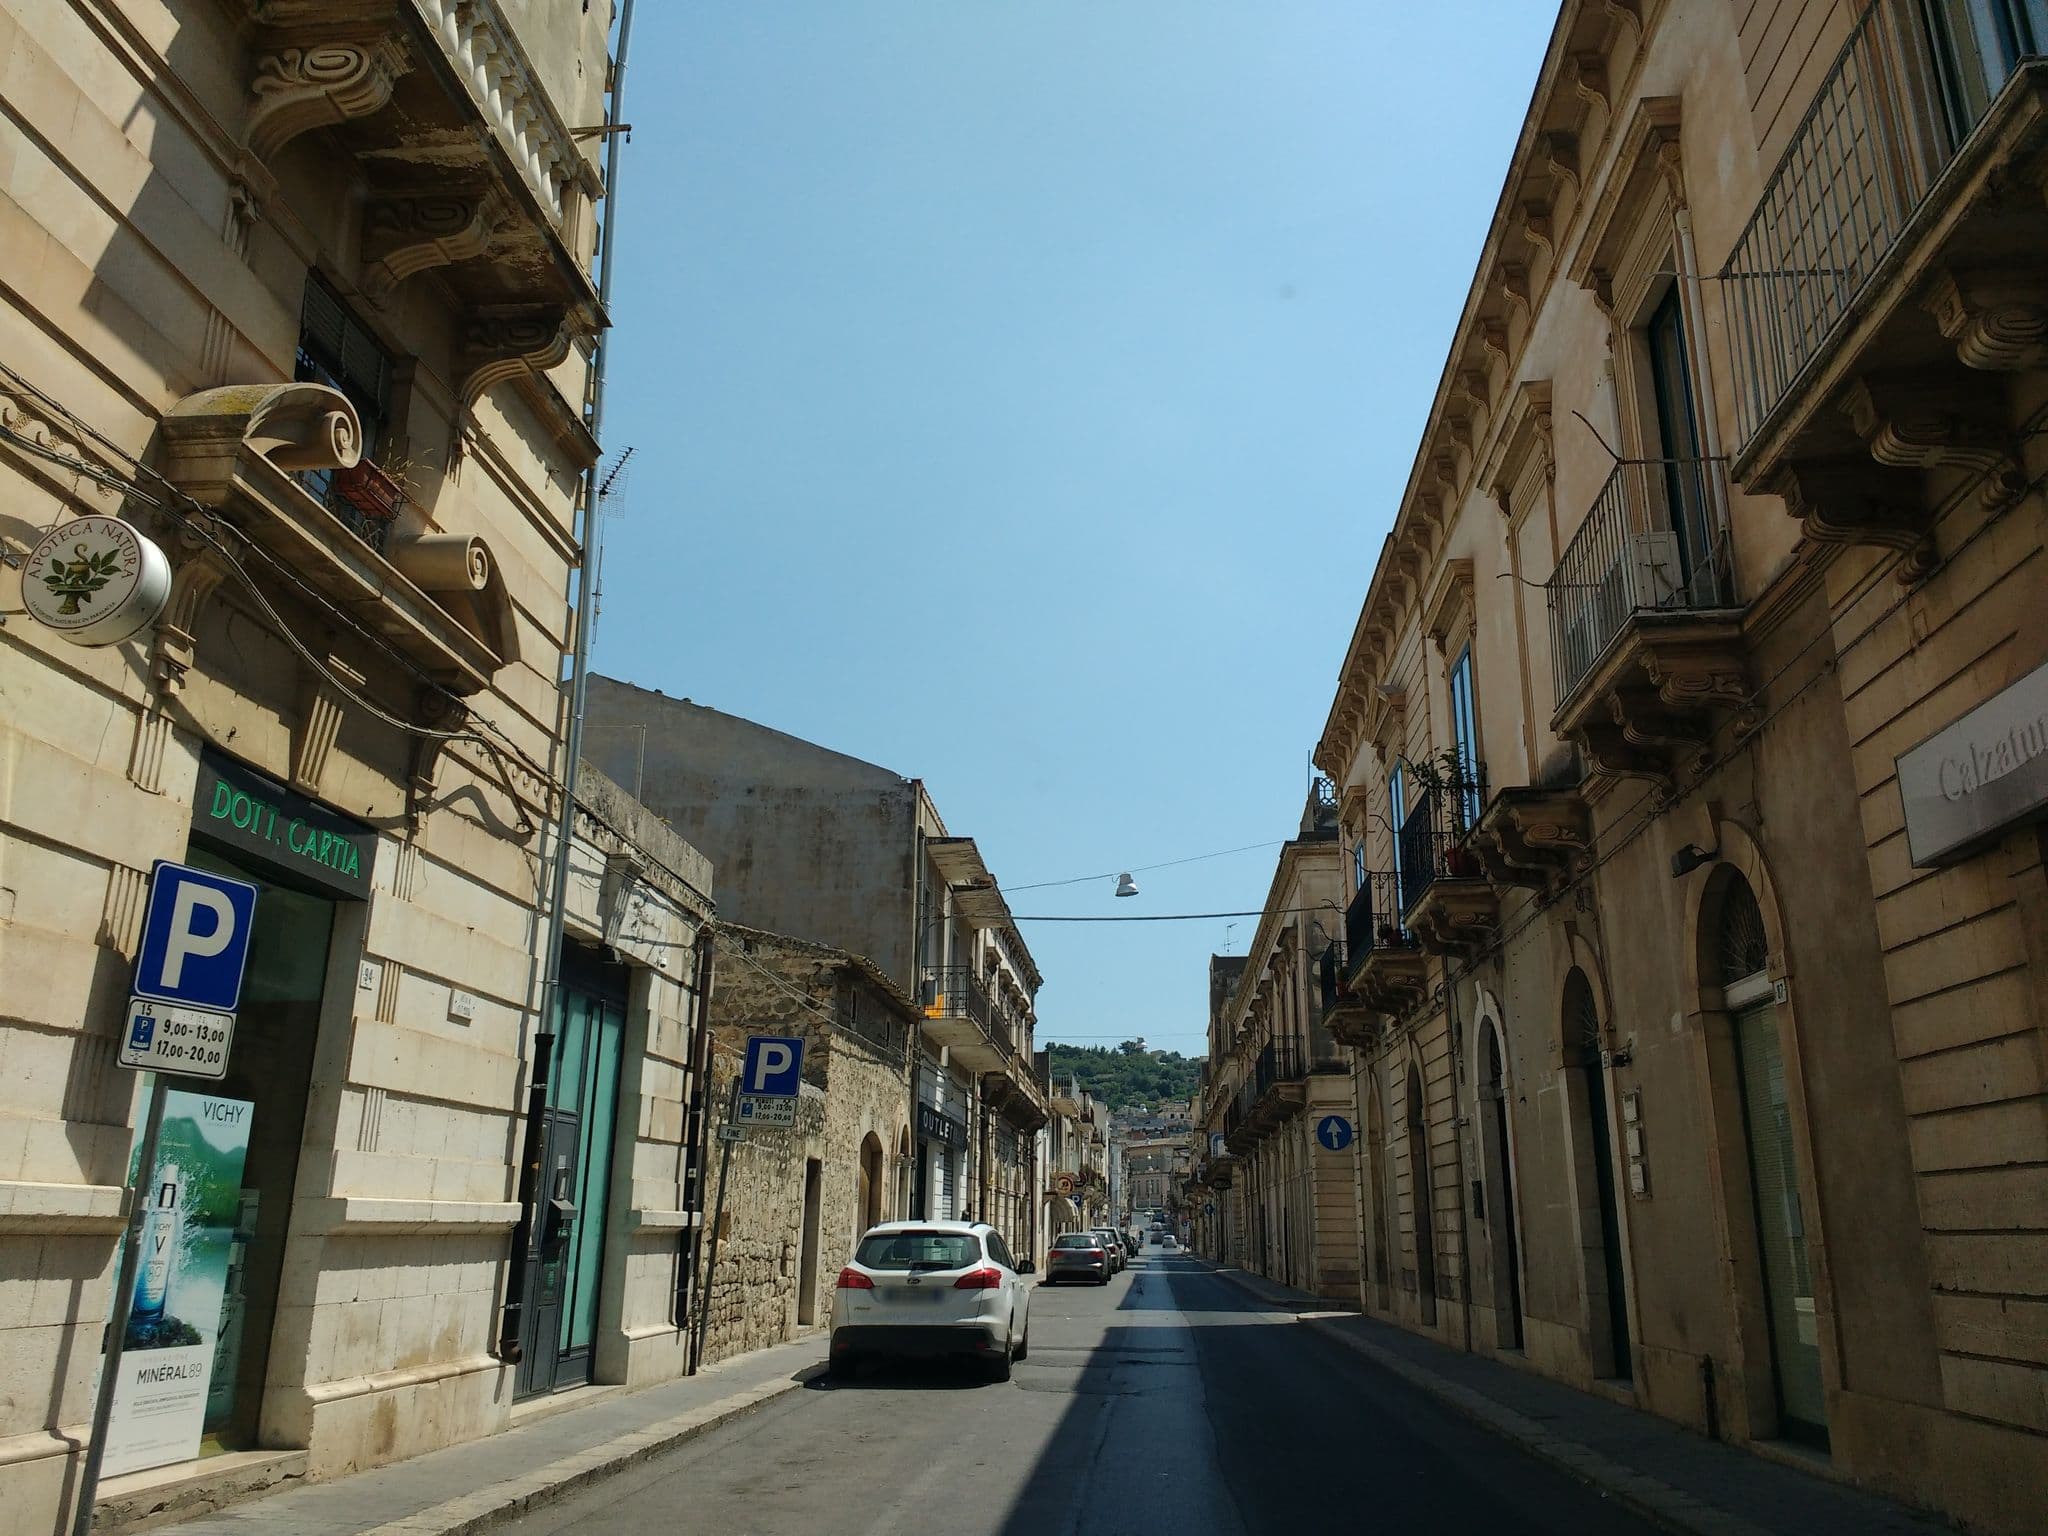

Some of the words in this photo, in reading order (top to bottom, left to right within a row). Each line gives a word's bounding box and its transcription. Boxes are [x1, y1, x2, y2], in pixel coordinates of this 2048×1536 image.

[28, 522, 93, 579] APOTECA
[100, 524, 137, 579] NATURA
[209, 778, 281, 846] DOTT.
[287, 817, 361, 879] CARTIA
[160, 880, 236, 989] P
[141, 1003, 153, 1016] 15
[753, 1042, 793, 1090] P
[203, 1101, 245, 1123] VICHY
[923, 1110, 954, 1141] OUTLET
[726, 1129, 741, 1139] FINE
[136, 1363, 187, 1385] MINÉRAL
[188, 1362, 202, 1379] 89
